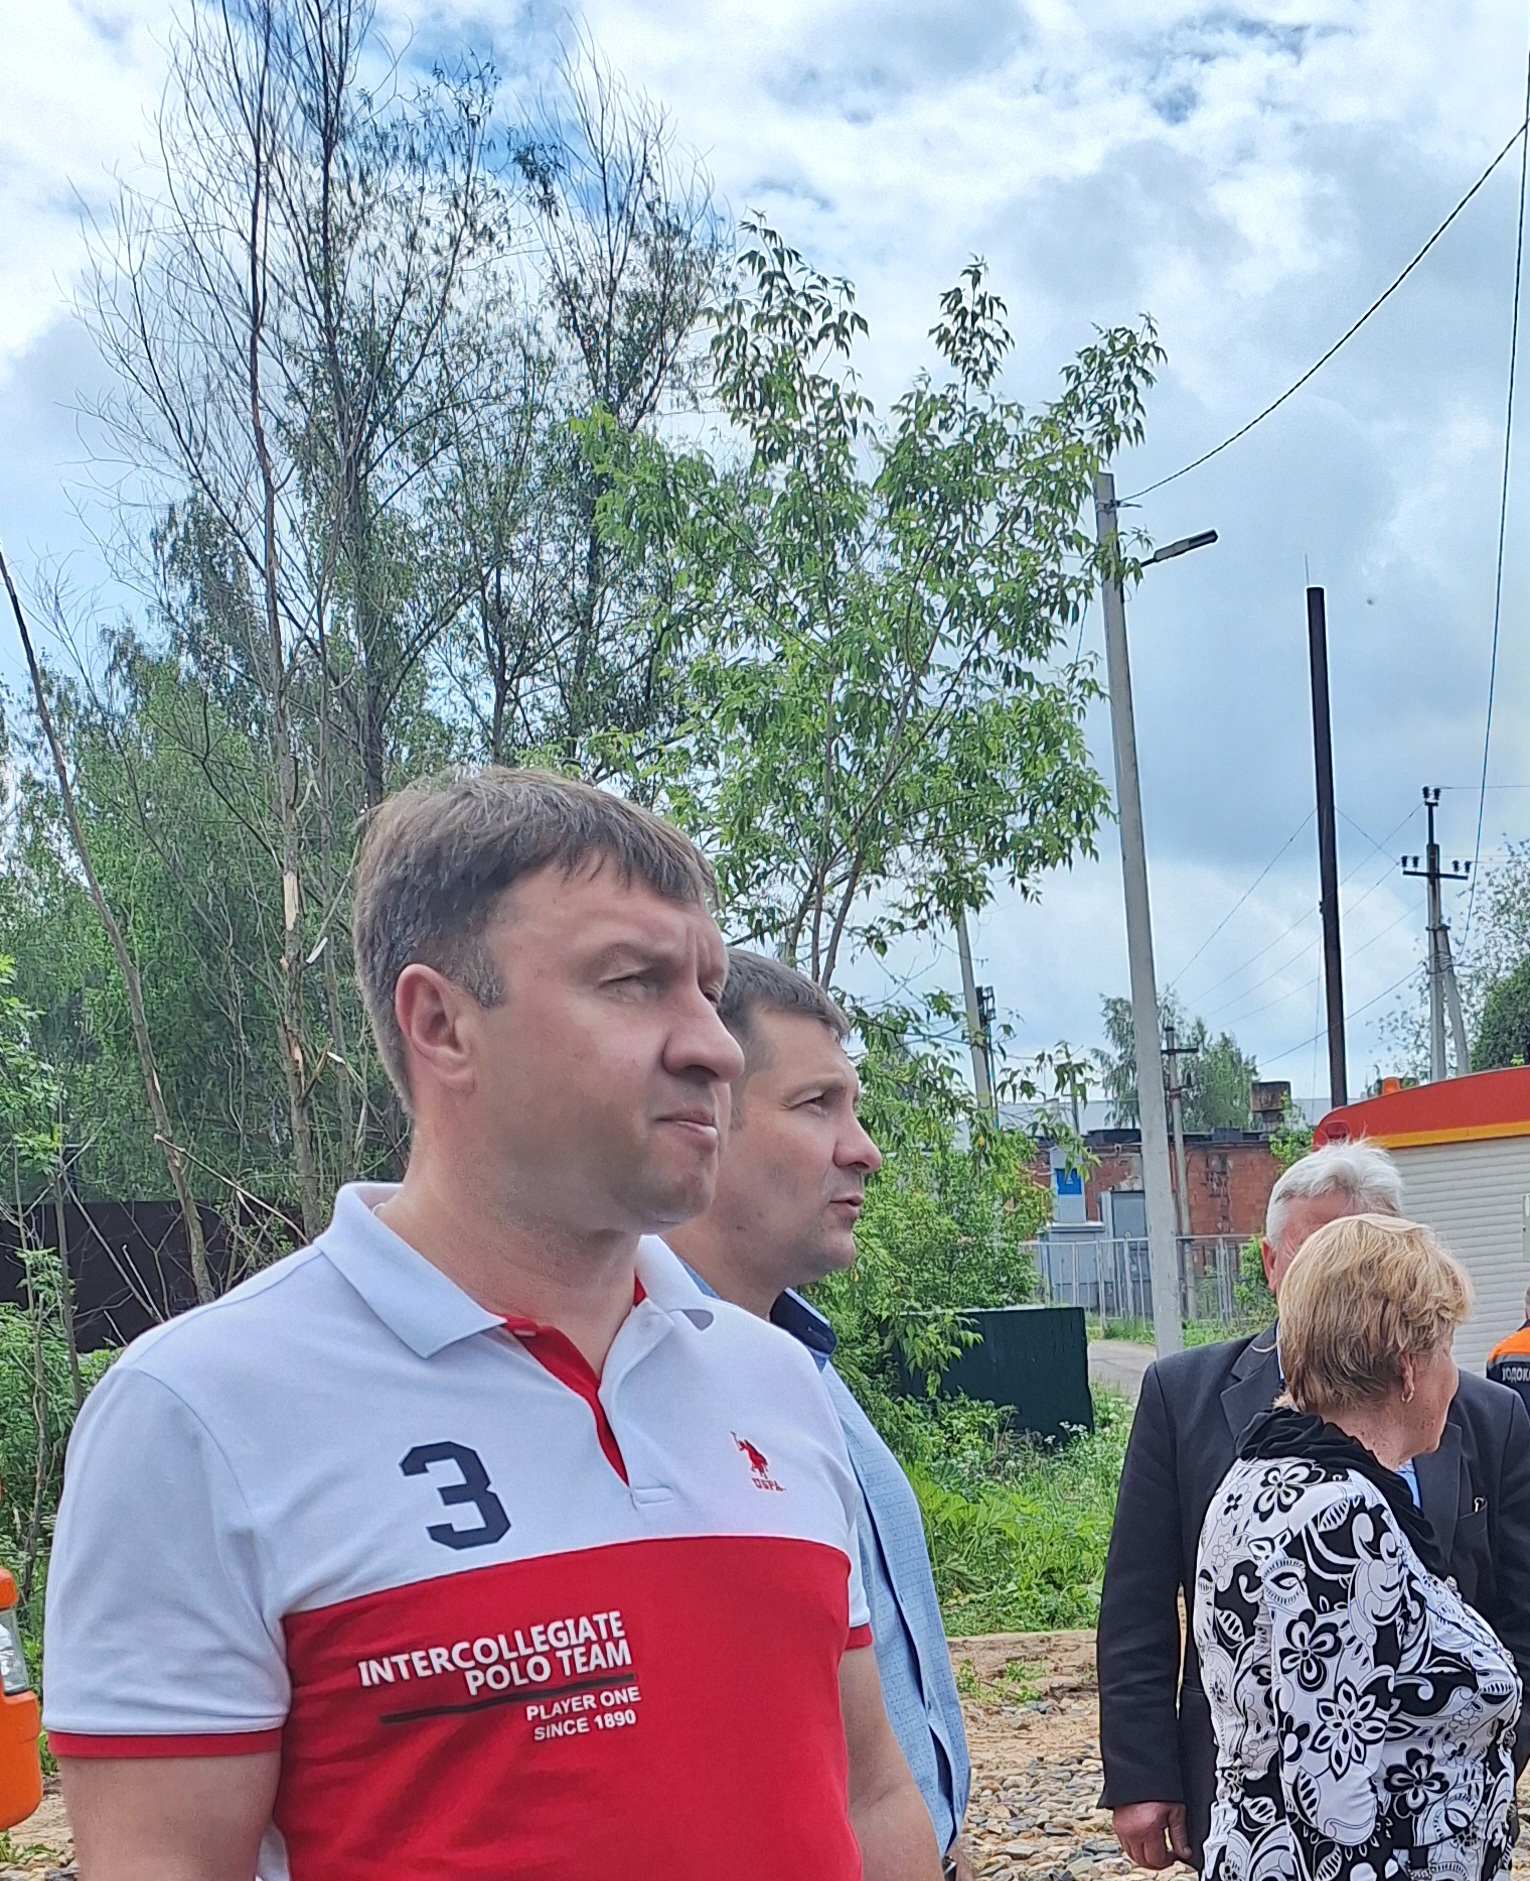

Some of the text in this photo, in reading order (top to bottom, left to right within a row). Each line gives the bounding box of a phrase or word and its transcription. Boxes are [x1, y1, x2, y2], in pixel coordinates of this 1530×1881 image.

[399, 1441, 511, 1550] 3
[358, 1610, 626, 1687] INTERCOLLEGIATE
[464, 1639, 633, 1696] POLO TEAM
[526, 1686, 642, 1722] PLAYER ONE
[533, 1708, 637, 1741] SINCE 1890
